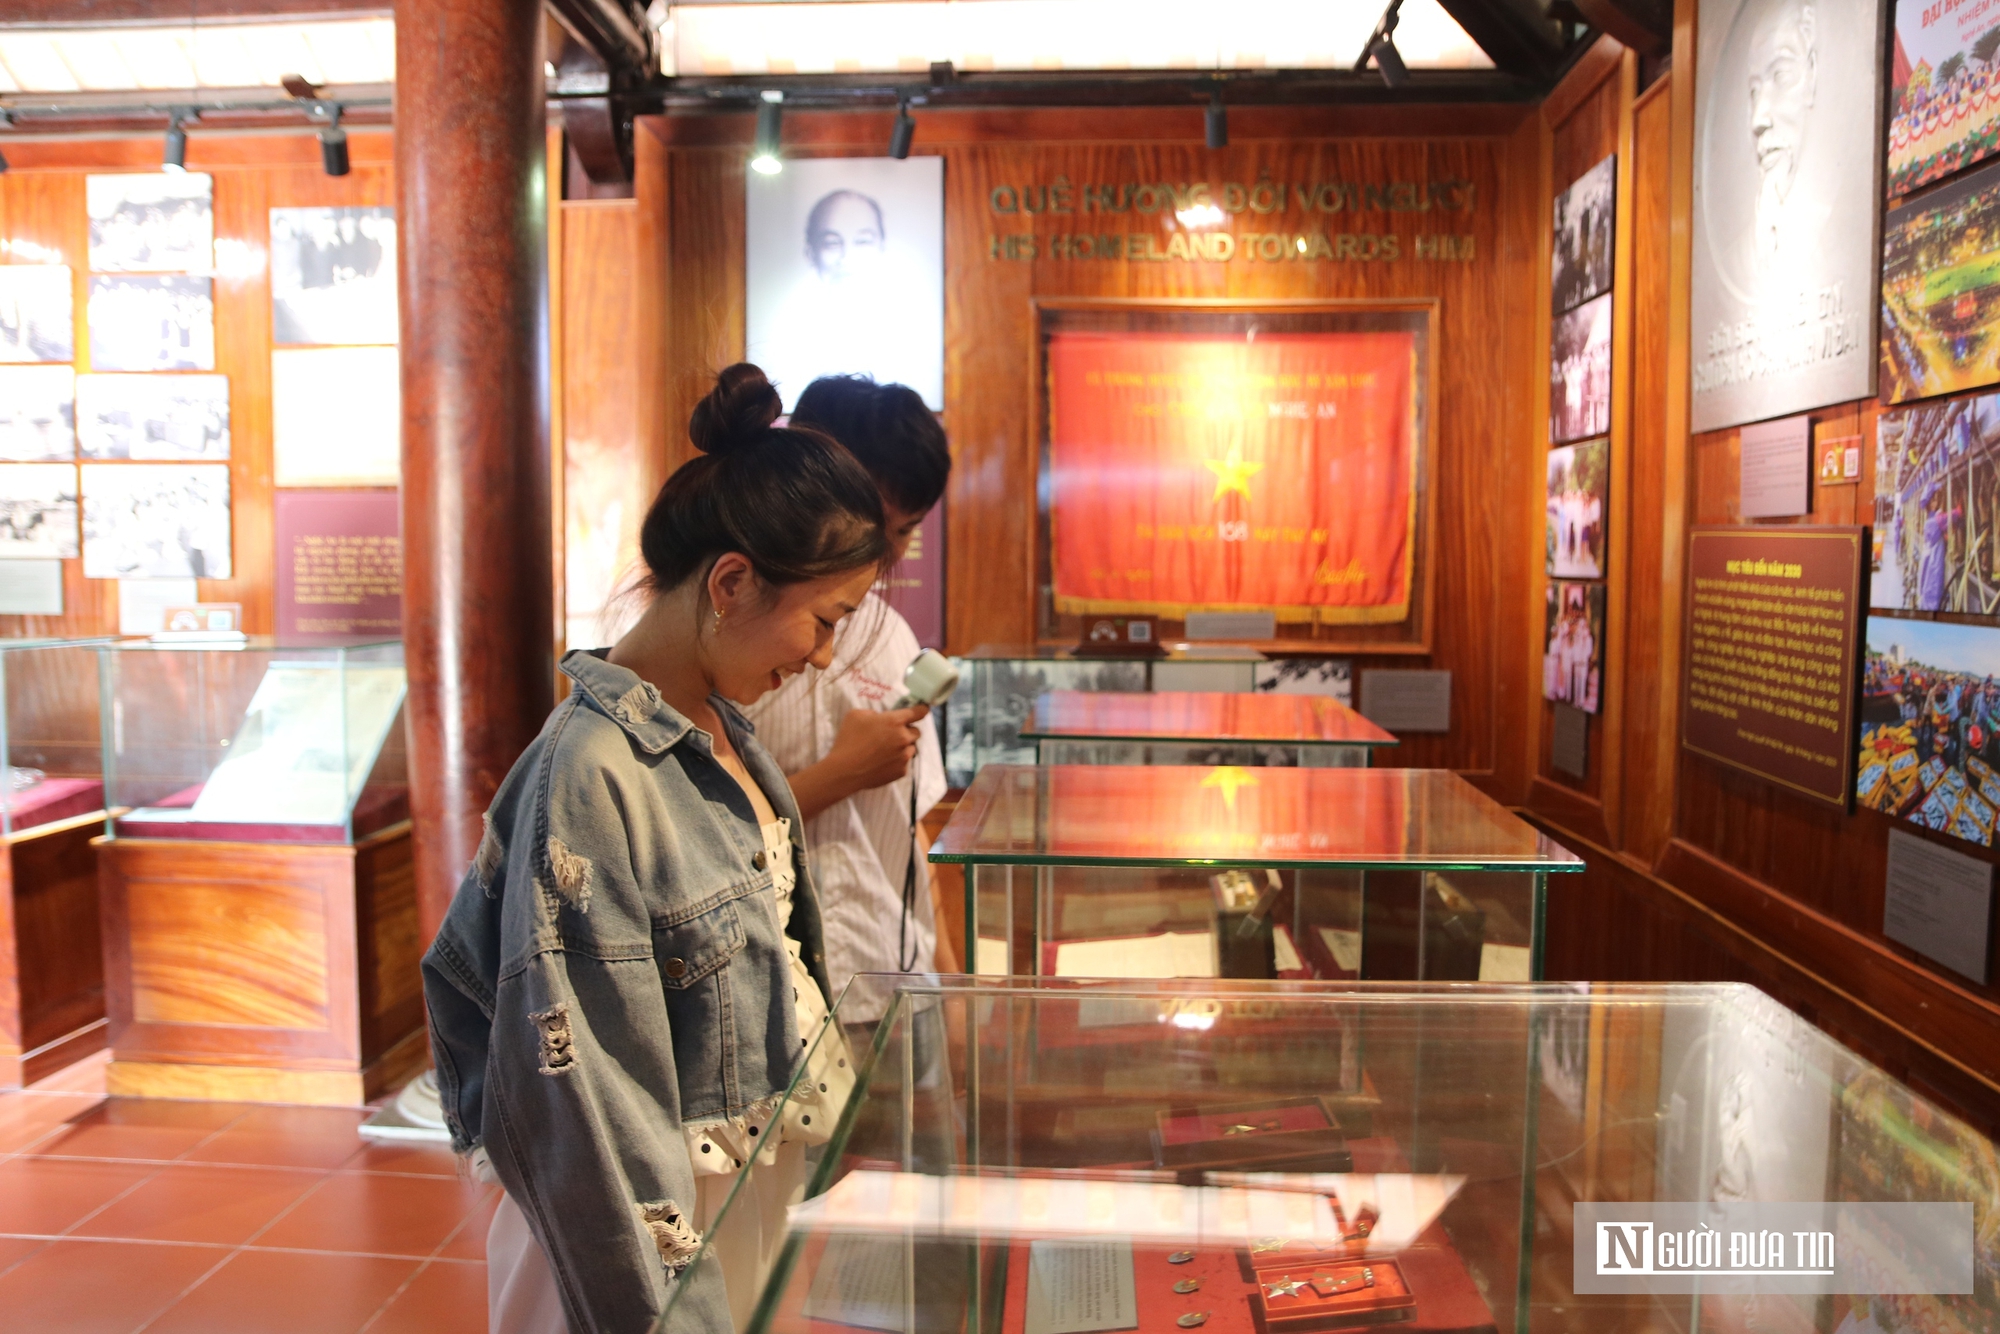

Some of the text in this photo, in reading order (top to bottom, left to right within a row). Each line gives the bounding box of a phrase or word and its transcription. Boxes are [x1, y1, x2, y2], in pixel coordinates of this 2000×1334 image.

[990, 174, 1074, 215] QUÊ
[1082, 180, 1209, 214] HƯƠNG
[1220, 168, 1286, 214] ĐỐI
[989, 232, 1476, 262] HIS HOMELAND TOWARDS HIM
[1218, 520, 1249, 542] 168
